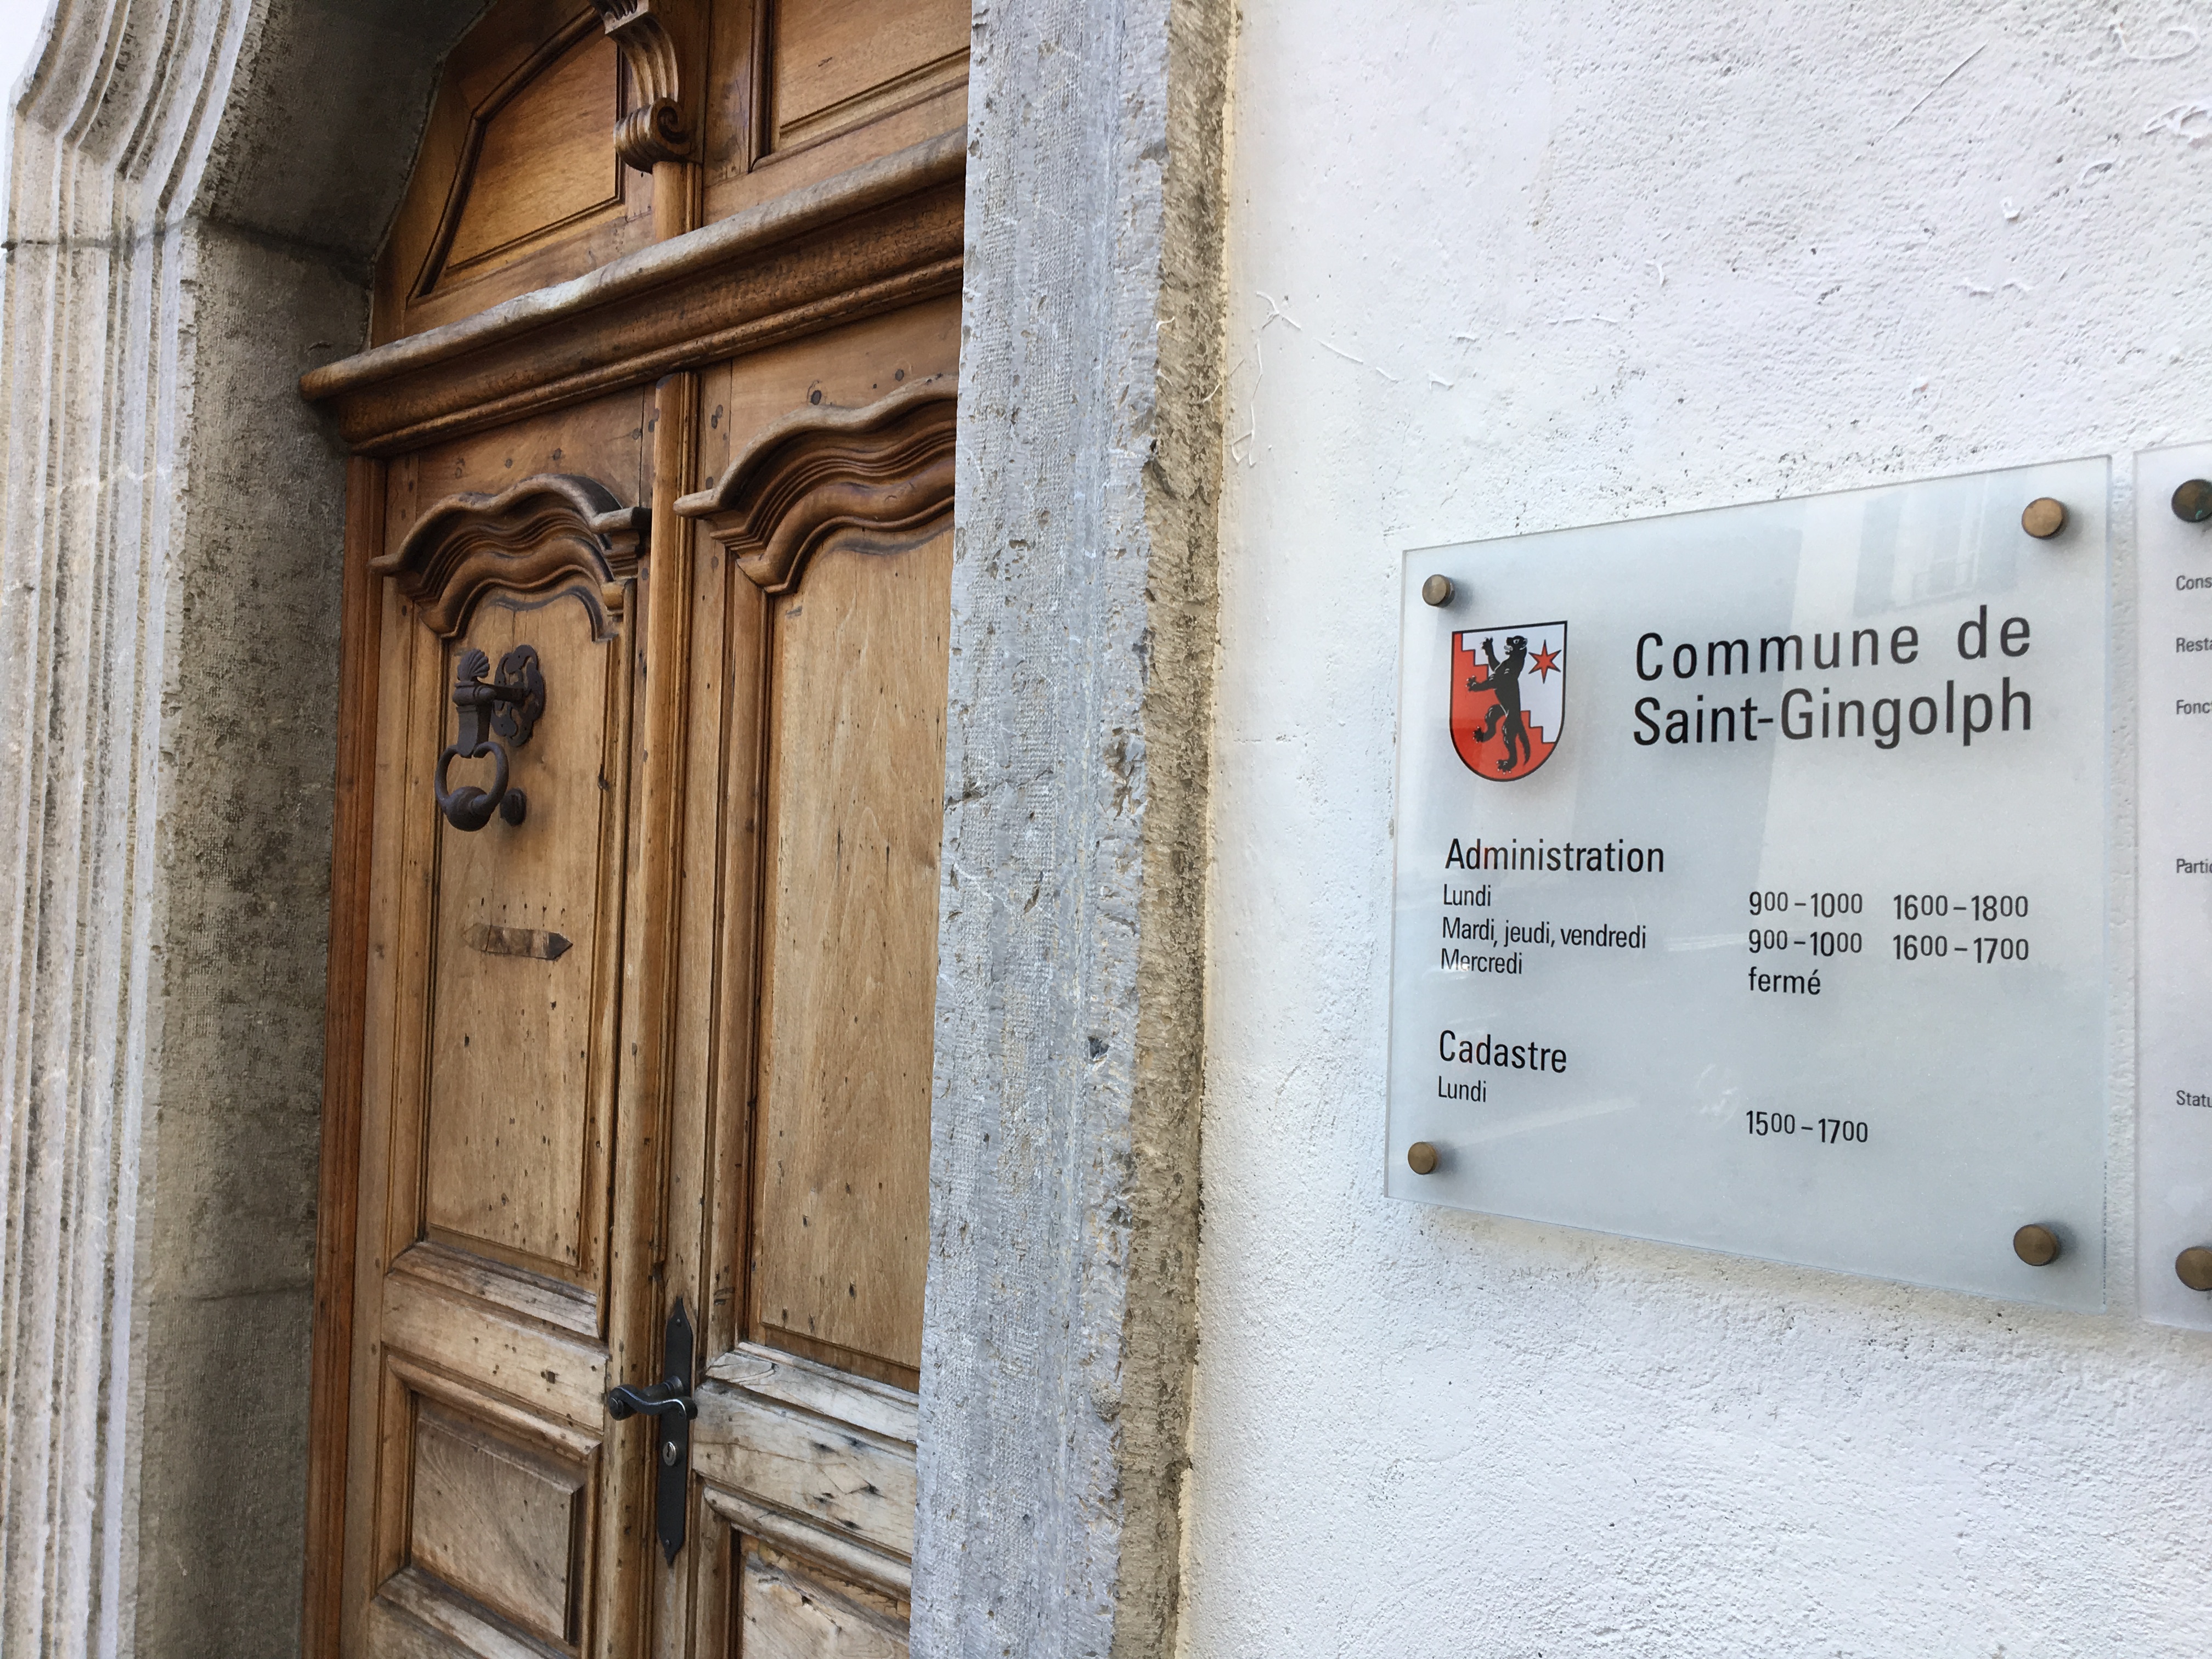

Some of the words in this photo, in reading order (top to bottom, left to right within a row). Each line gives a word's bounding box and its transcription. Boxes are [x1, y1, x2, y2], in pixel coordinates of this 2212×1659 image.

[1636, 631, 1919, 682] Commune
[1957, 604, 2030, 661] de
[1633, 676, 2032, 750] Saint-Gingolph
[1444, 838, 1664, 873] Administration
[1443, 883, 1491, 907] Lundi
[1442, 916, 1498, 948] Mardi,
[1503, 919, 1556, 948] jeudi,
[1560, 923, 1646, 950] vendredi
[1441, 948, 1522, 975] Mercredi
[1748, 966, 1821, 996] fermé
[1439, 1029, 1567, 1074] Cadastre
[1438, 1075, 1487, 1103] Lundi
